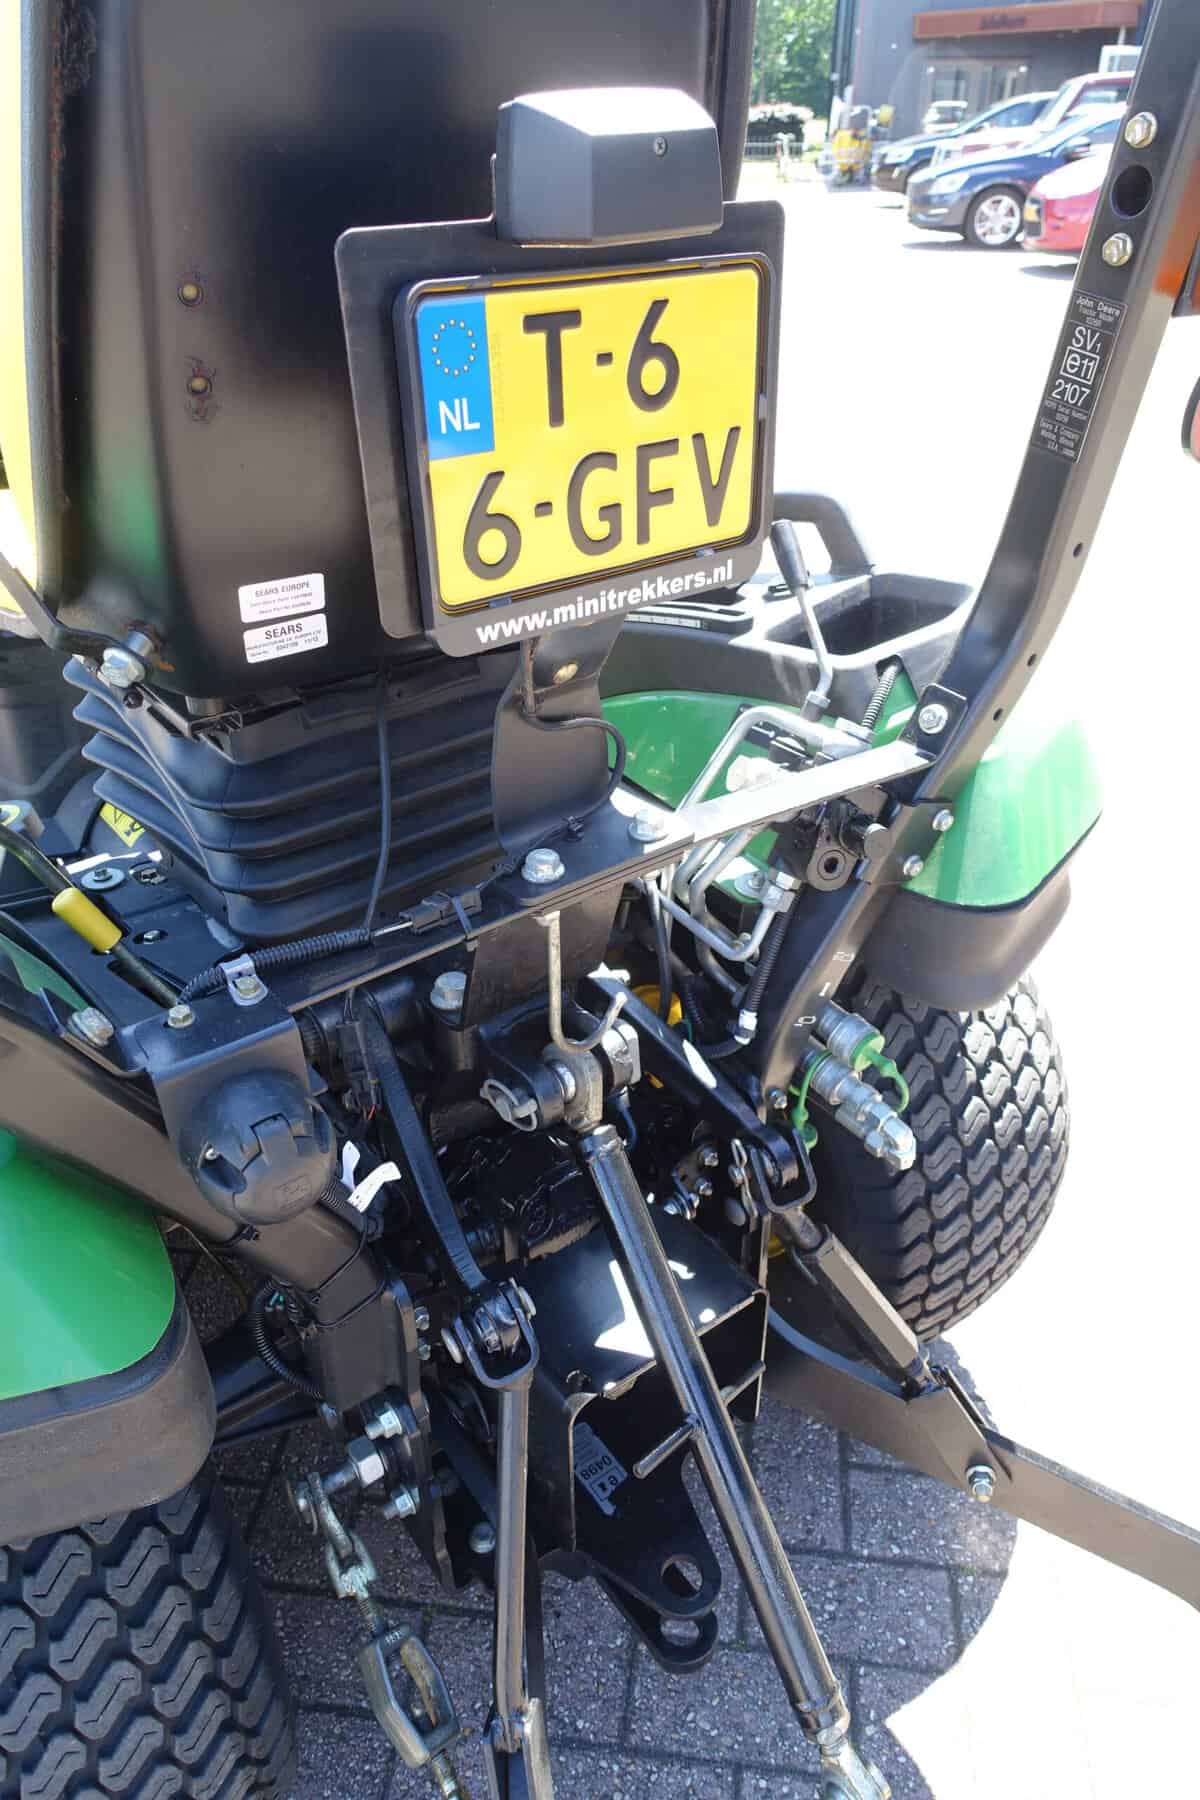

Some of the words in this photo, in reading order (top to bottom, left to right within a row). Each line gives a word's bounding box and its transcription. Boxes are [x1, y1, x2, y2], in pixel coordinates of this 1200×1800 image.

[522, 298, 680, 428] T-6
[1066, 352, 1095, 380] e11
[1051, 379, 1091, 407] 2107
[438, 397, 481, 435] NL
[462, 426, 742, 580] 6-GFV
[475, 559, 734, 645] www.minitrekkers.nl
[265, 623, 303, 640] SEARS
